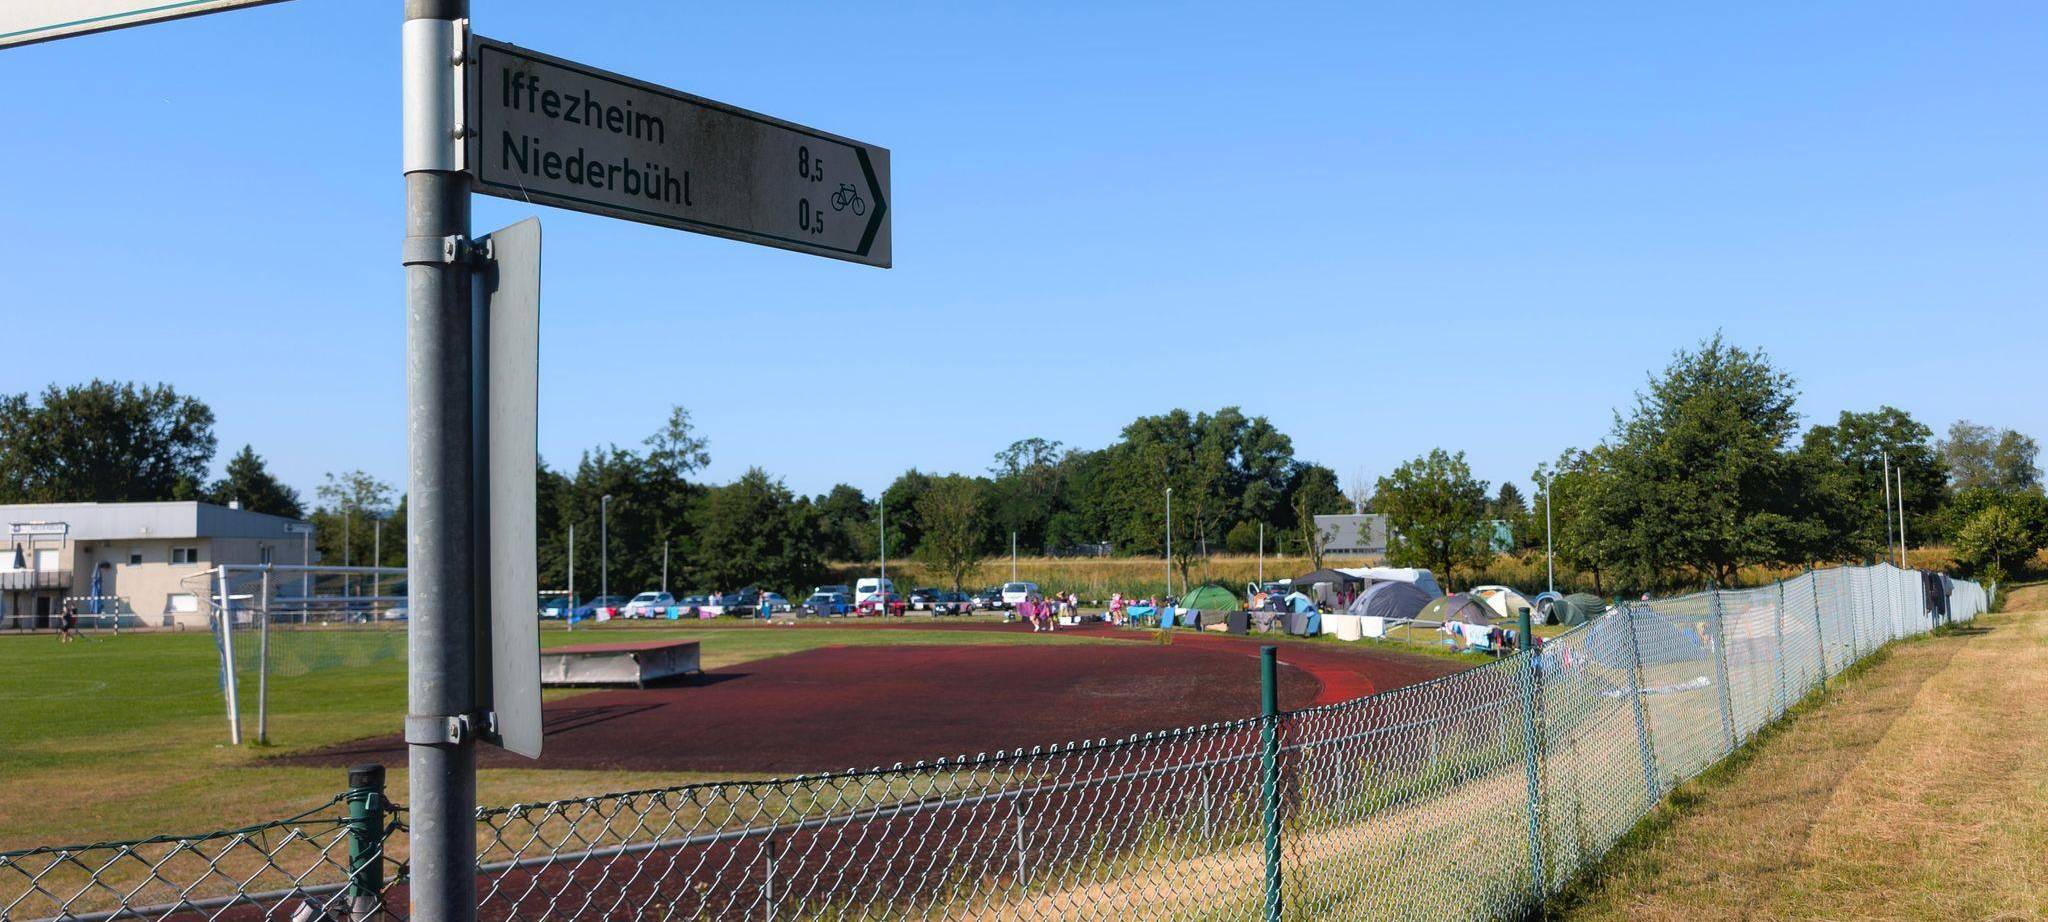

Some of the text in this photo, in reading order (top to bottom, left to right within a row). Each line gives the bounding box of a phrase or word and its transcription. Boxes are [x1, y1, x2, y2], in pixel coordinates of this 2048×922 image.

[503, 68, 823, 182] Iffezheim 8,5
[503, 130, 823, 235] Niederbühl 0,5
